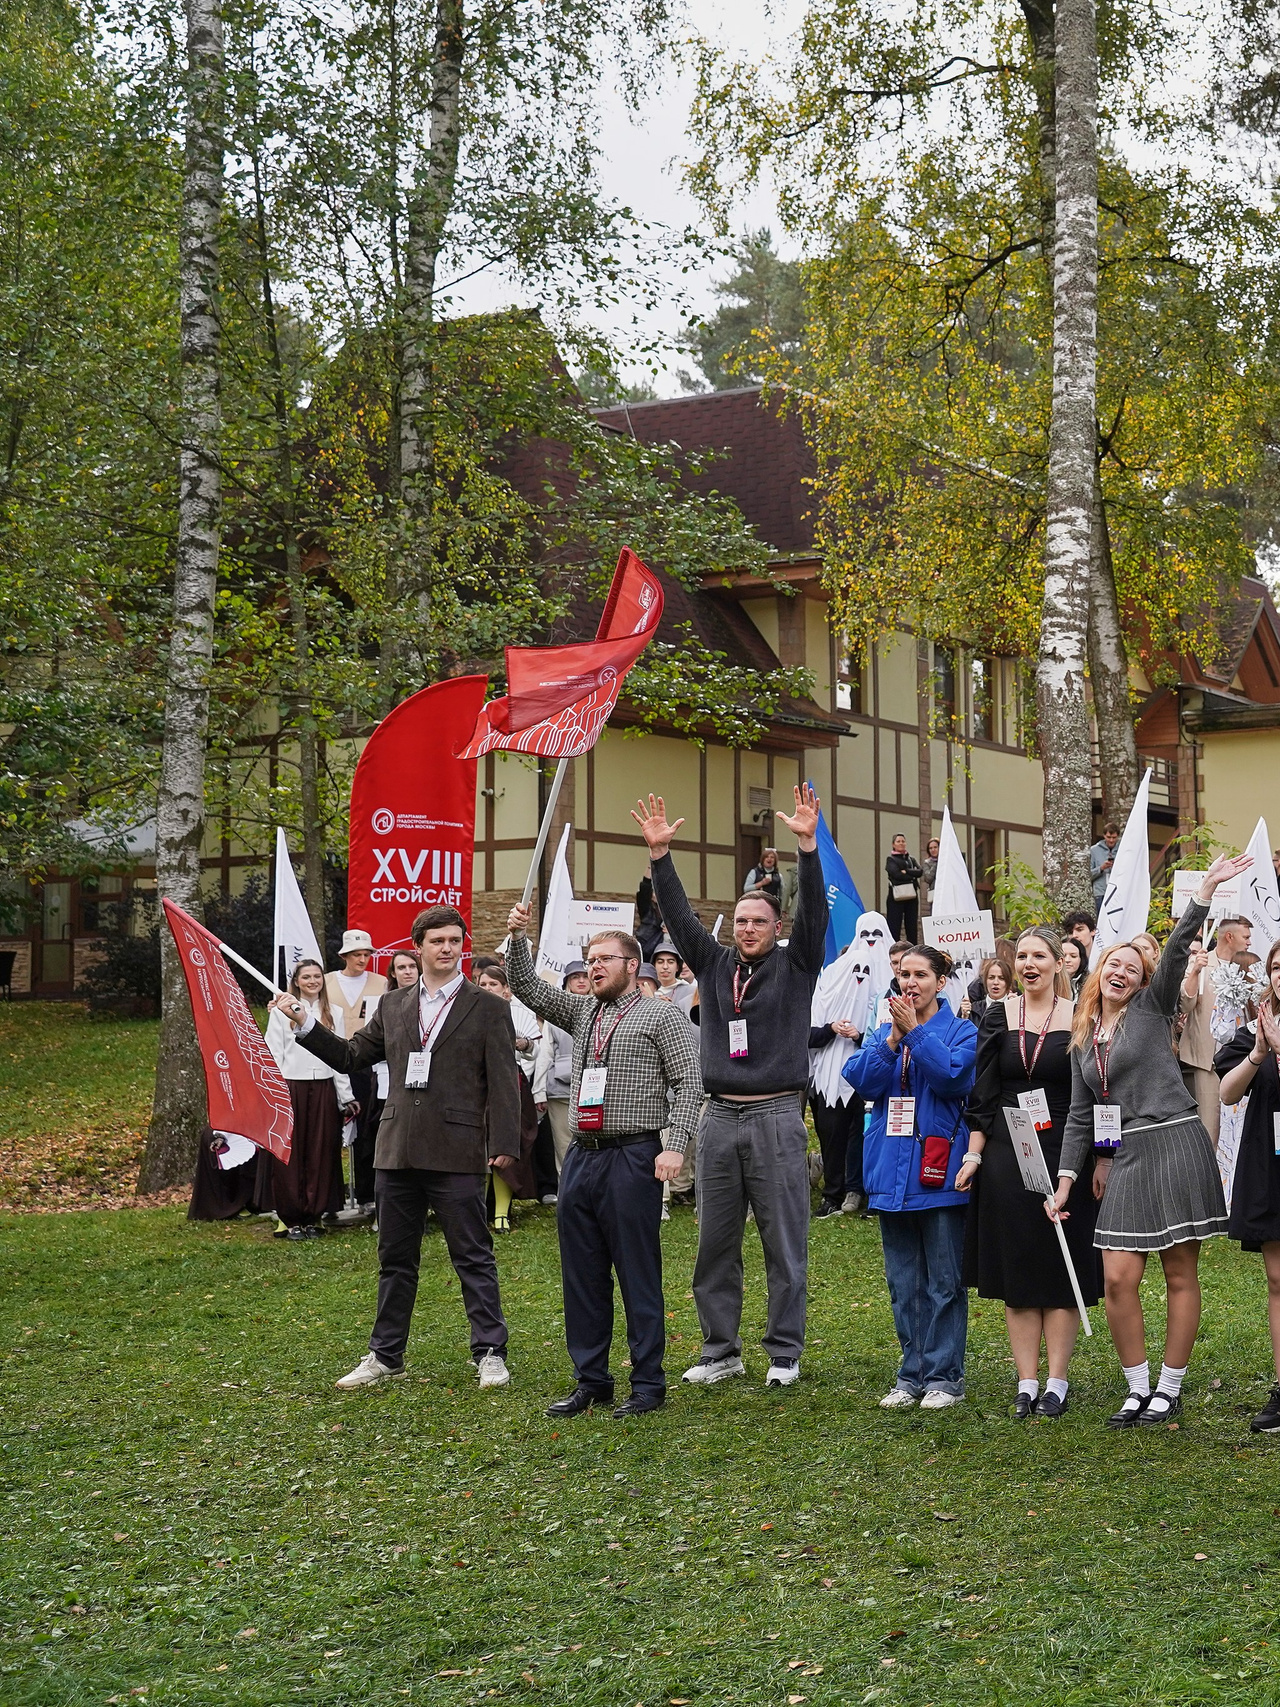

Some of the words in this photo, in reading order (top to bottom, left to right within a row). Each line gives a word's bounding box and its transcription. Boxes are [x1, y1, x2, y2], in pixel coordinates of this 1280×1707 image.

[371, 848, 462, 887] XVIII
[370, 885, 463, 906] СТРОЙСЛЁТ
[938, 931, 980, 943] КОЛДИ
